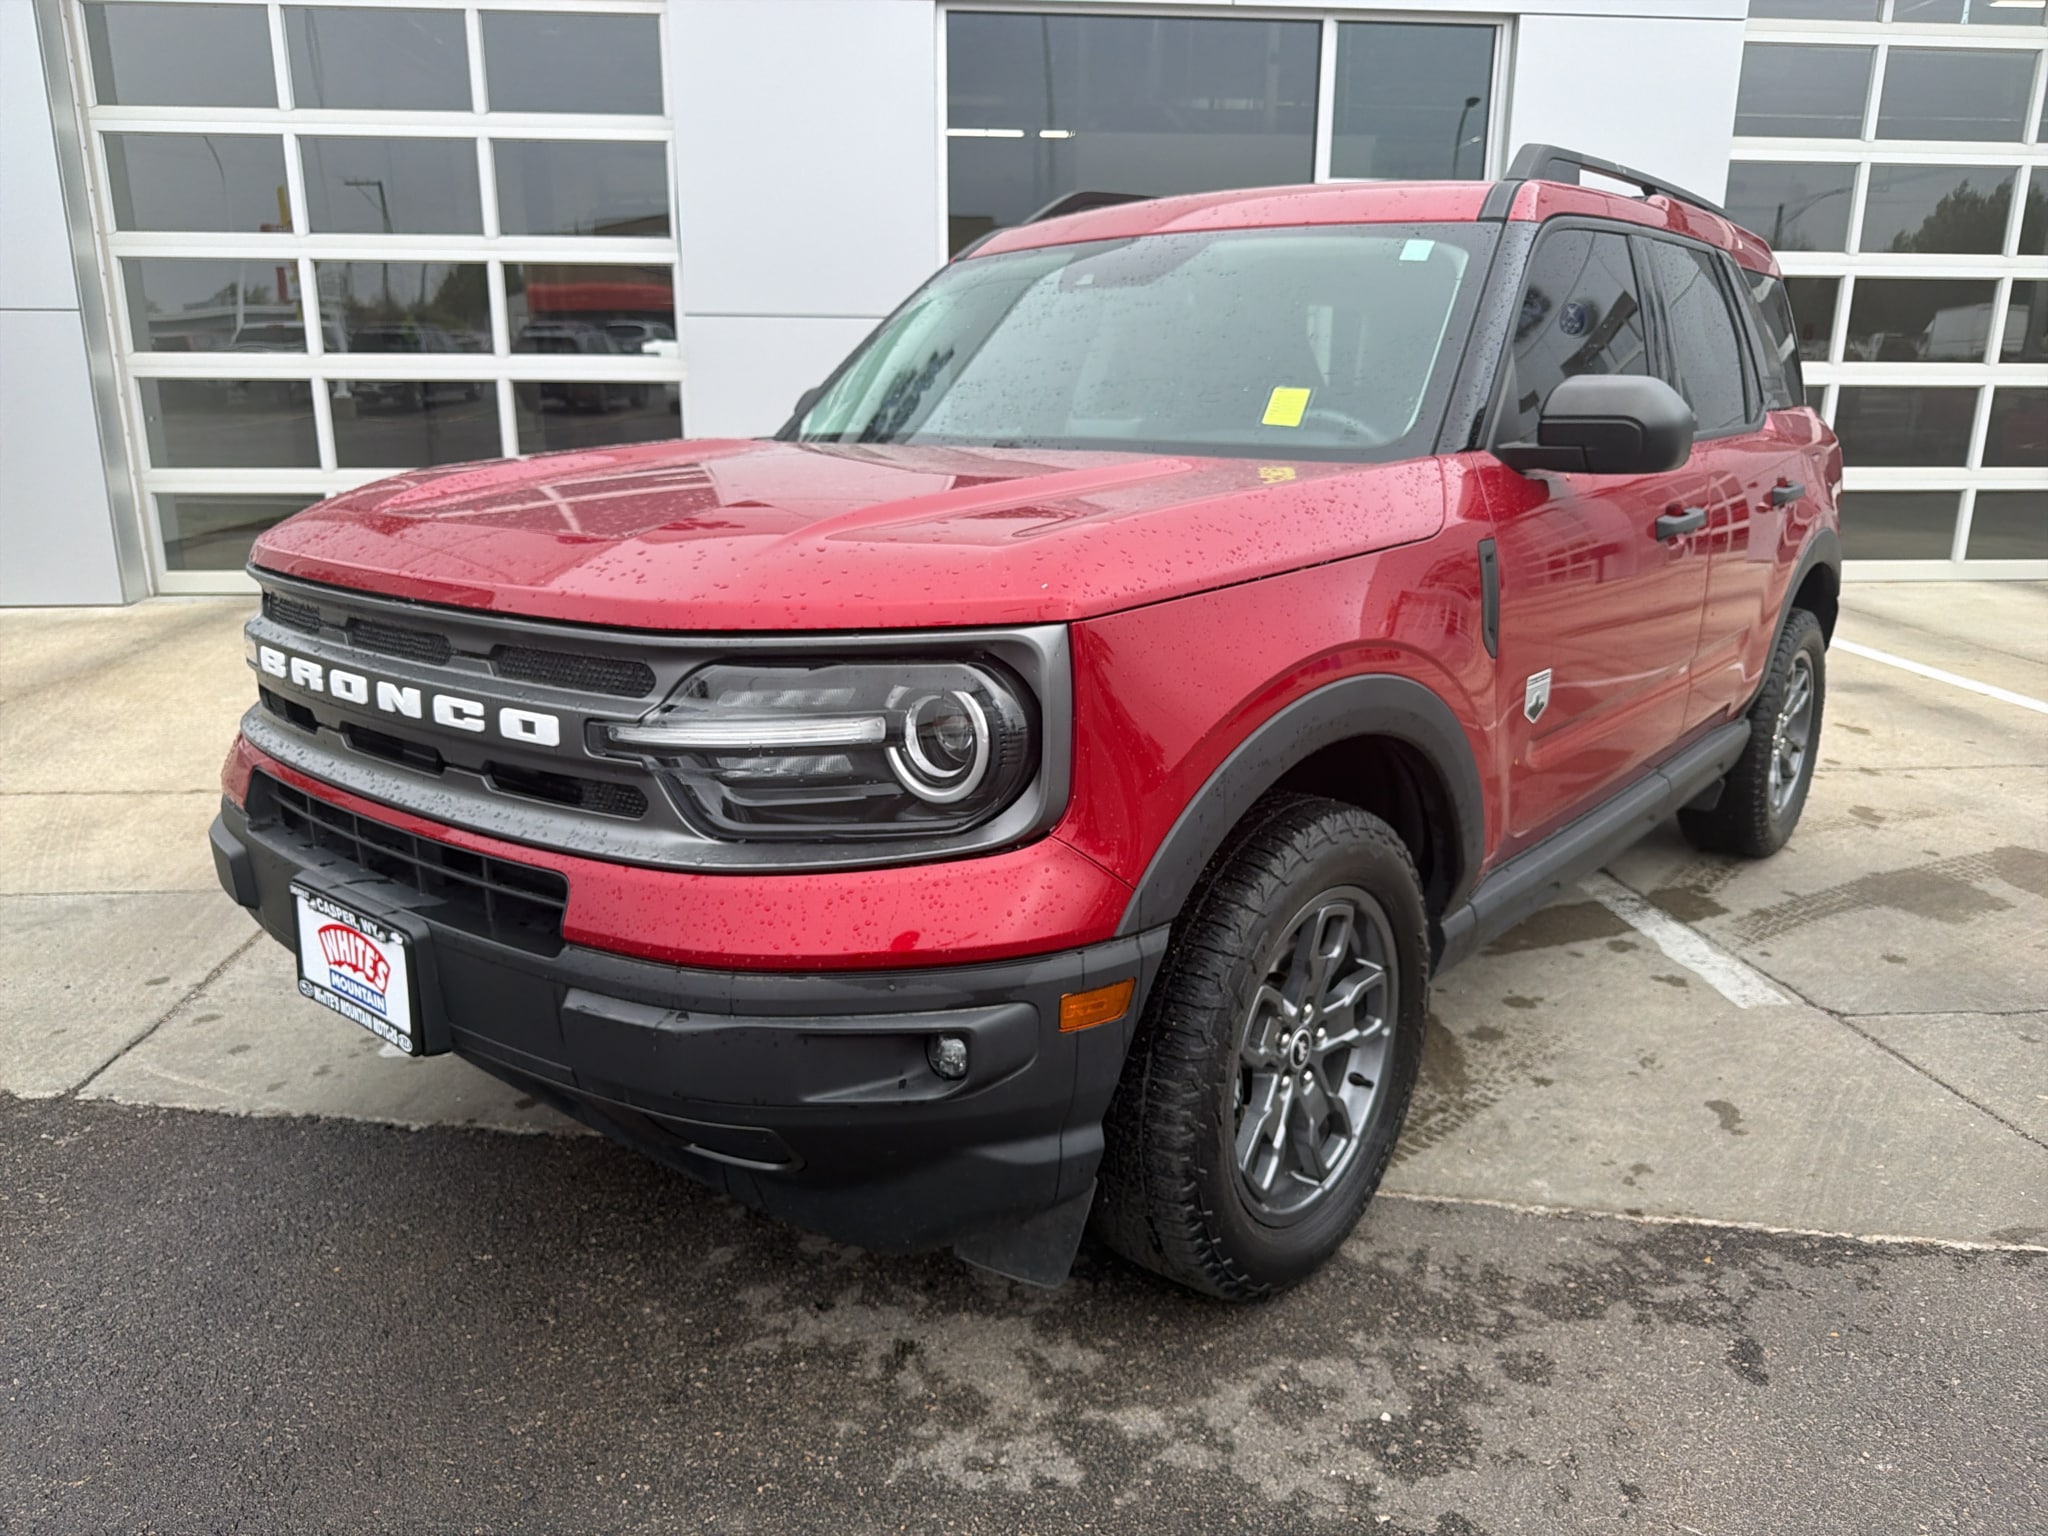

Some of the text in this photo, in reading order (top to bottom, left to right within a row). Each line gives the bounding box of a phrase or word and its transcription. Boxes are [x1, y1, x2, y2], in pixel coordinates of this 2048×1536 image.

[259, 645, 560, 747] BRONCO
[320, 928, 388, 994] WHITE'S
[331, 973, 385, 1012] MOUNTAIN
[340, 998, 372, 1030] MOUNTAIN
[372, 1016, 398, 1045] MOTORS
